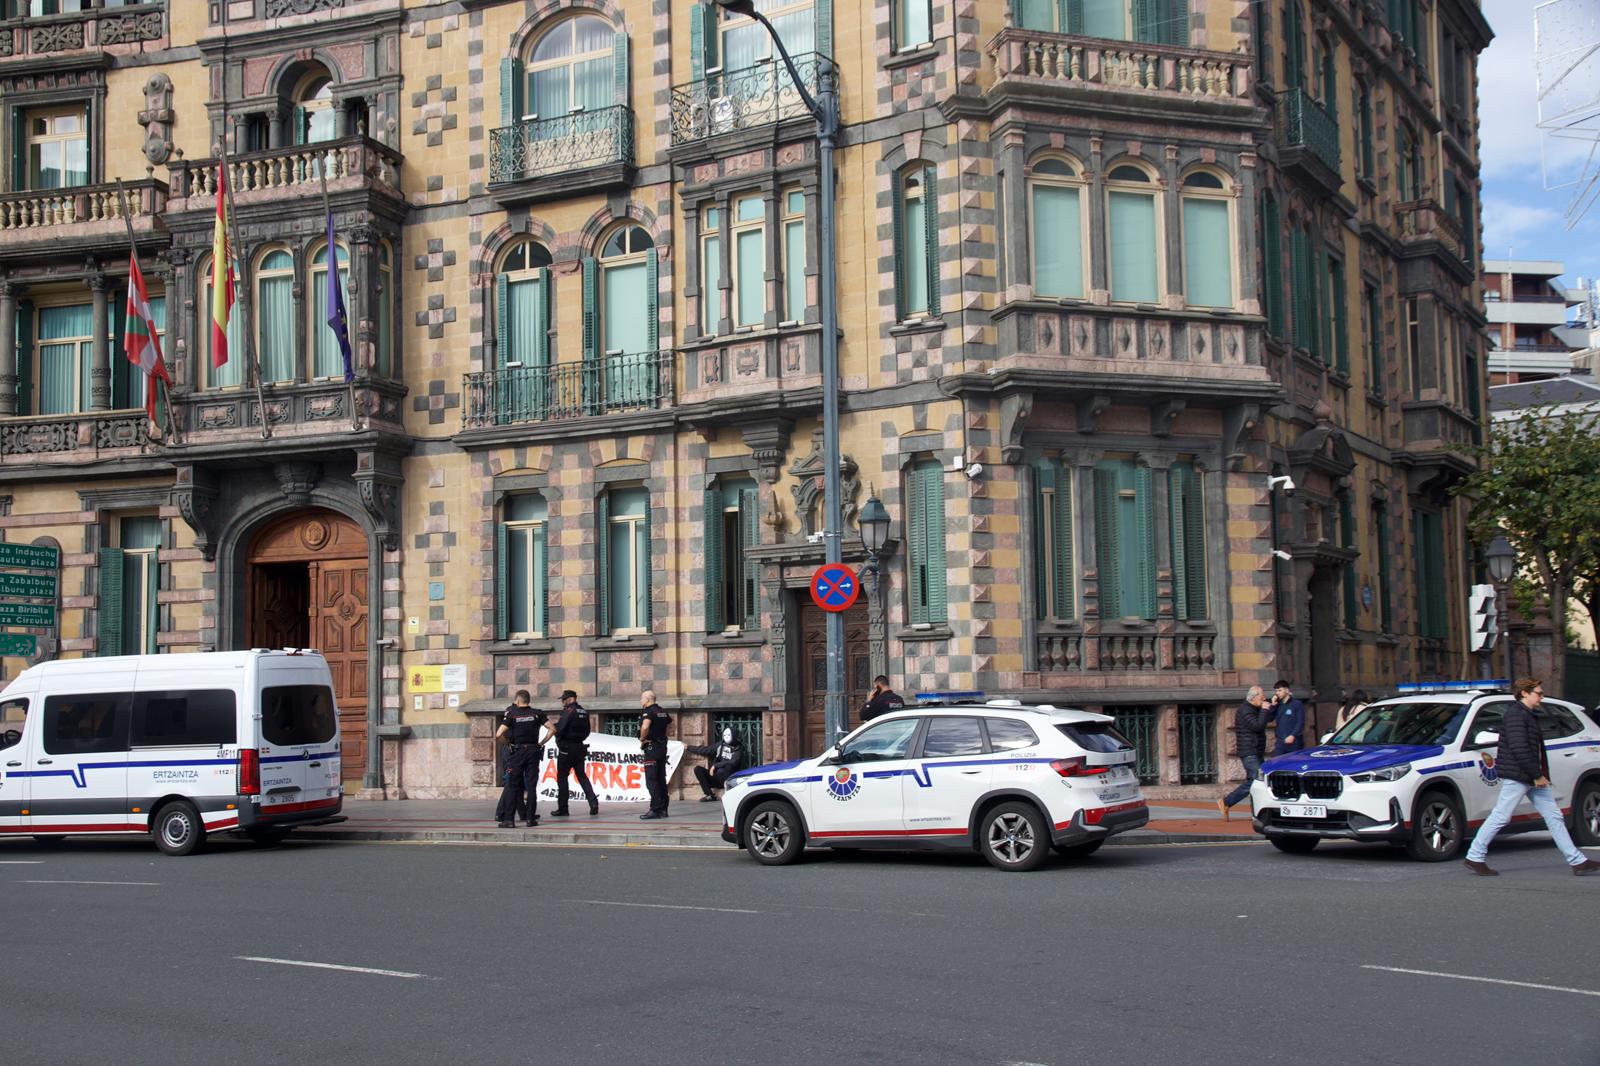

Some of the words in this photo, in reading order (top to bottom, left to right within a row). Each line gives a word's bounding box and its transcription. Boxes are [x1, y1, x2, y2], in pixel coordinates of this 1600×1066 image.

[15, 547, 56, 558] Indauchu
[31, 559, 55, 567] plaza
[9, 576, 54, 586] Zabalburu
[1, 586, 25, 594] lburu
[18, 606, 49, 614] Biribila
[16, 616, 52, 625] Circular
[153, 770, 199, 779] ERTZAINTZA
[826, 784, 861, 802] ERTZAINTZA
[1302, 806, 1323, 816] 2871
